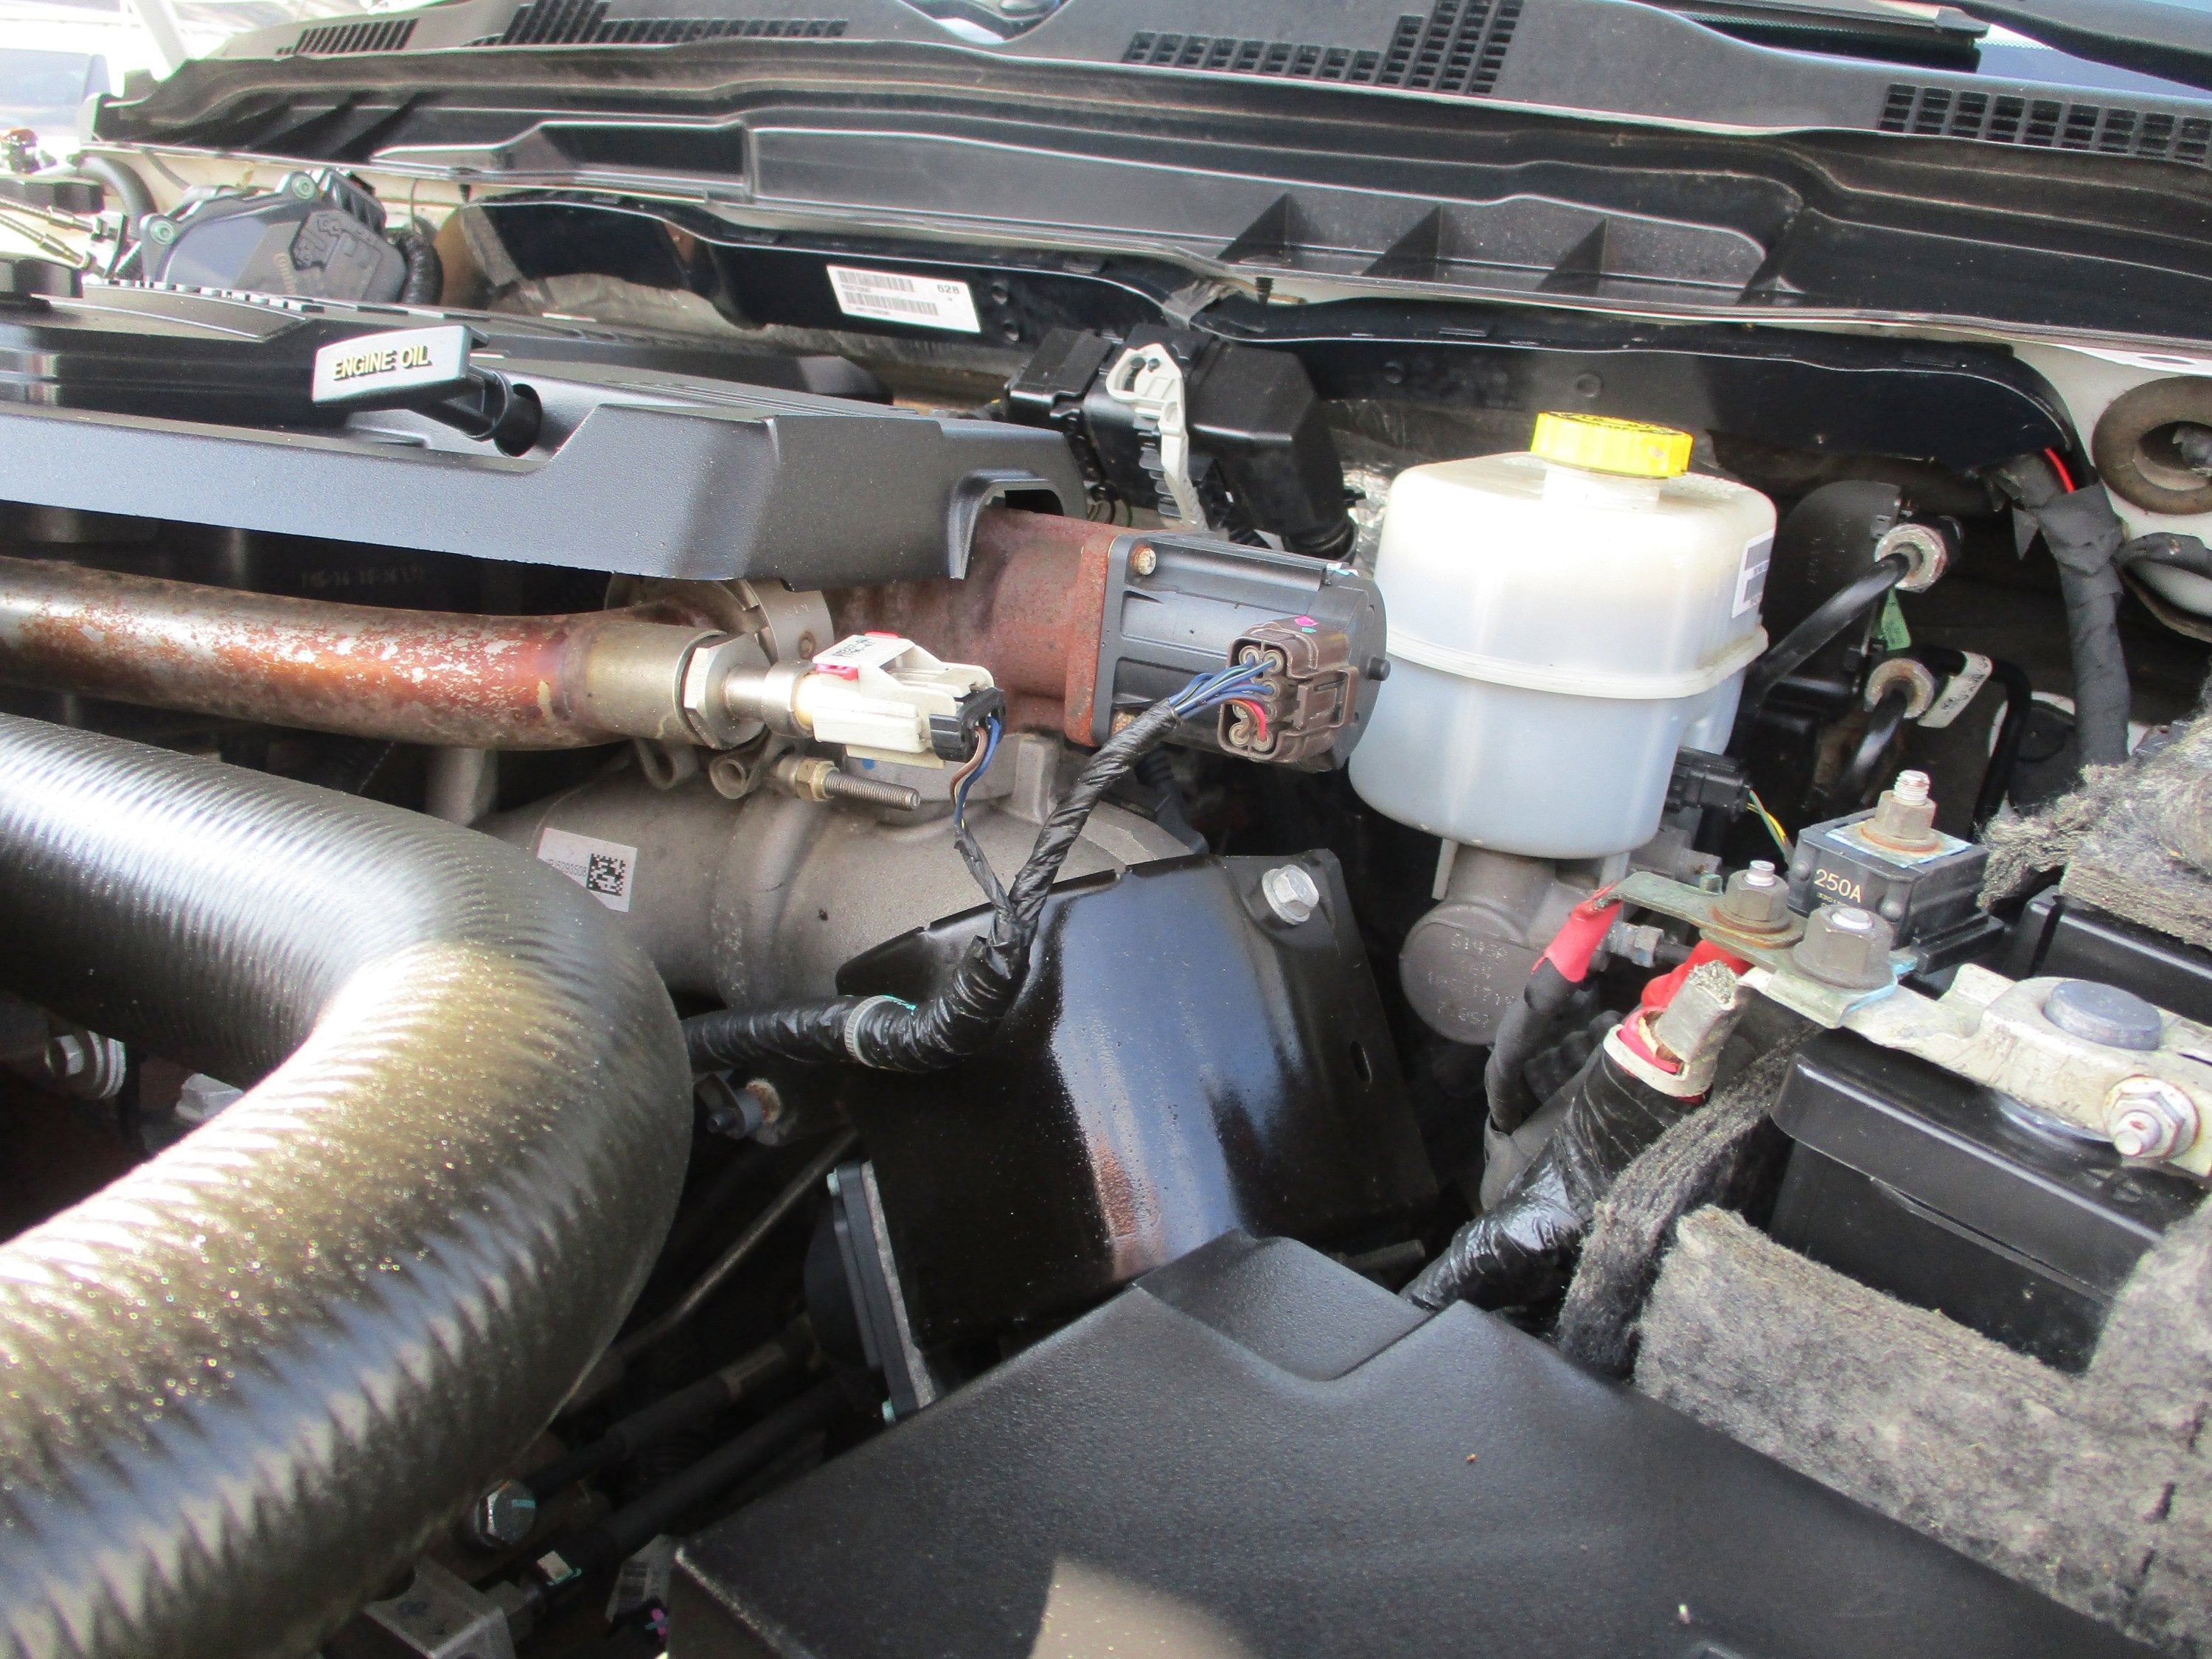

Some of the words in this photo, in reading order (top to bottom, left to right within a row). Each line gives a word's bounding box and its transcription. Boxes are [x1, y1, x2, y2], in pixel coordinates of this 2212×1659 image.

[936, 283, 961, 294] 628
[332, 349, 397, 380] ENGINE
[399, 344, 433, 369] OIL
[1814, 869, 1862, 903] 250A
